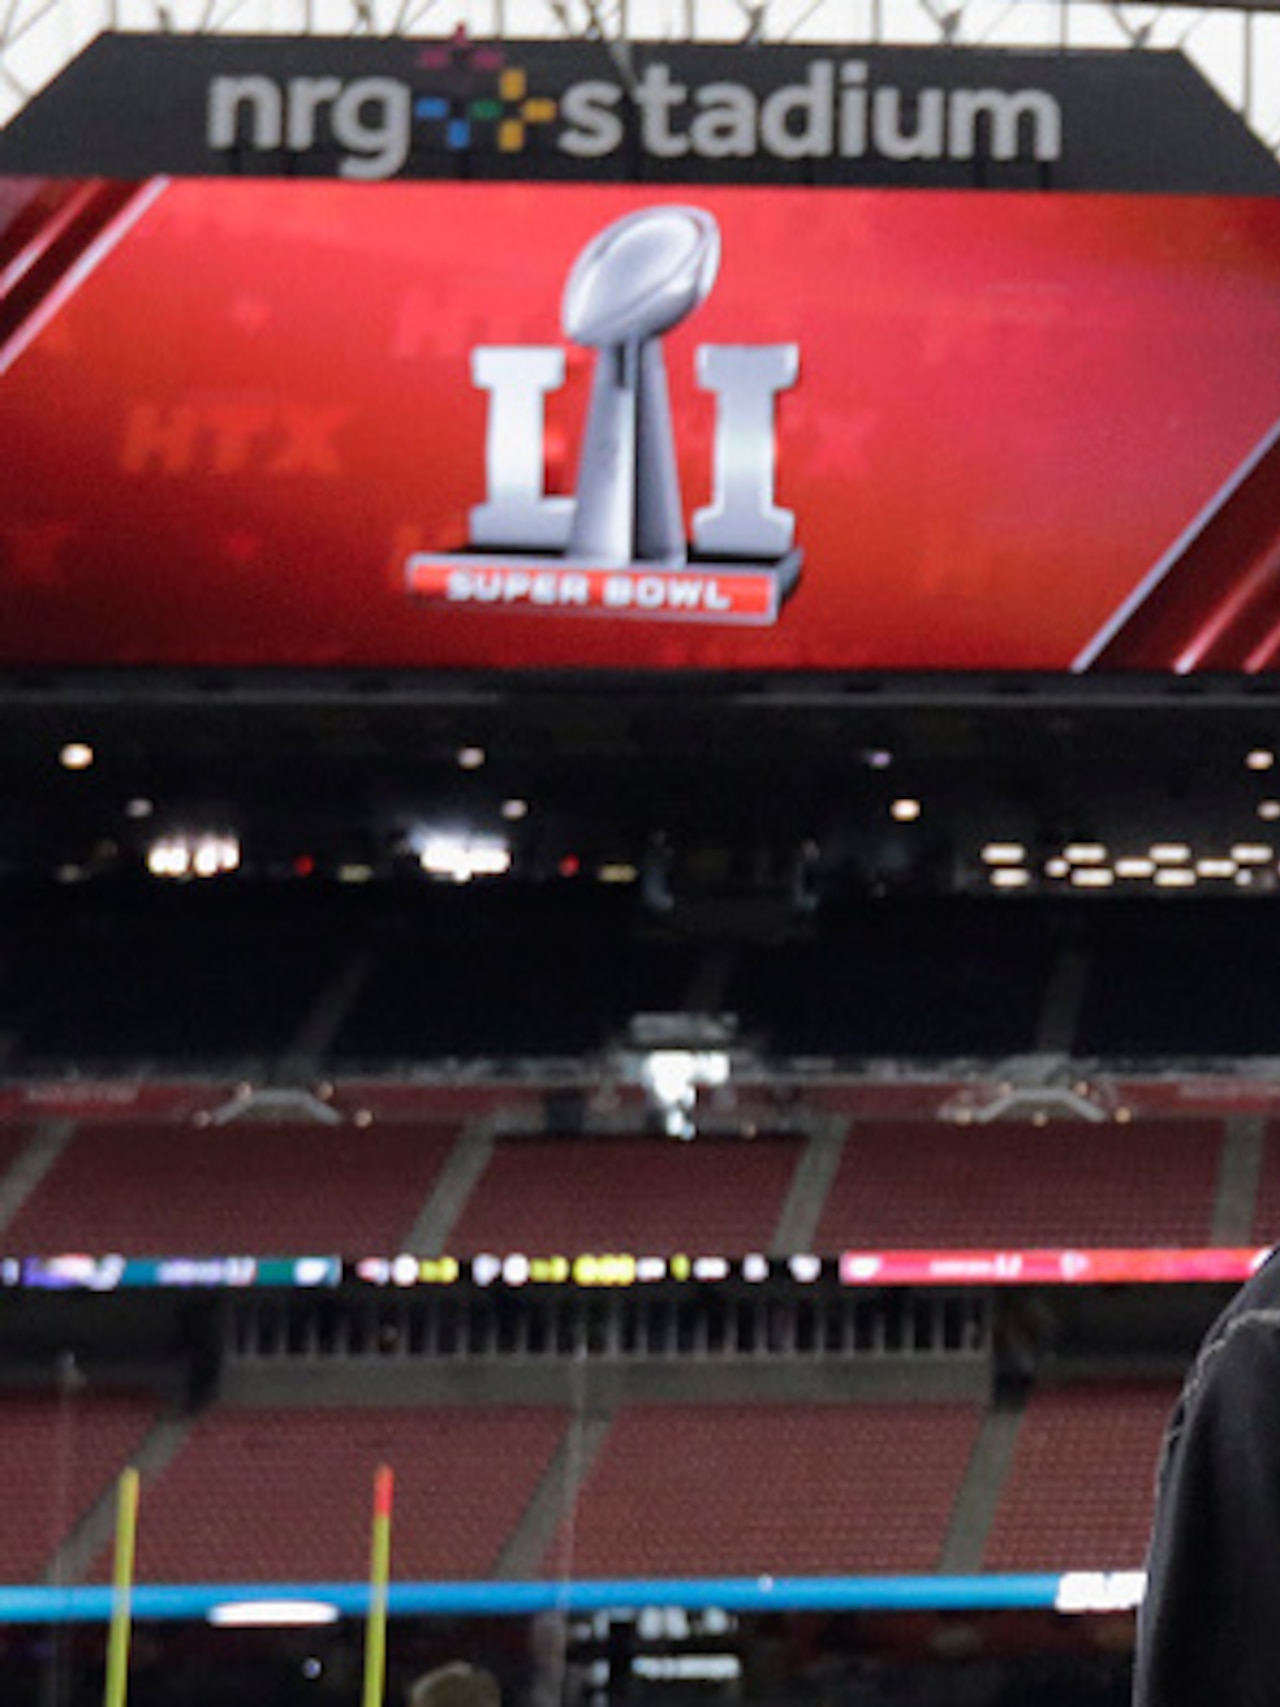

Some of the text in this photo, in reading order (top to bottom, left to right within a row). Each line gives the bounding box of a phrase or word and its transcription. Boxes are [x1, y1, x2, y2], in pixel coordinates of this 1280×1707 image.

[207, 58, 1063, 181] nrg stadium
[446, 566, 732, 611] SUPER BOWL
